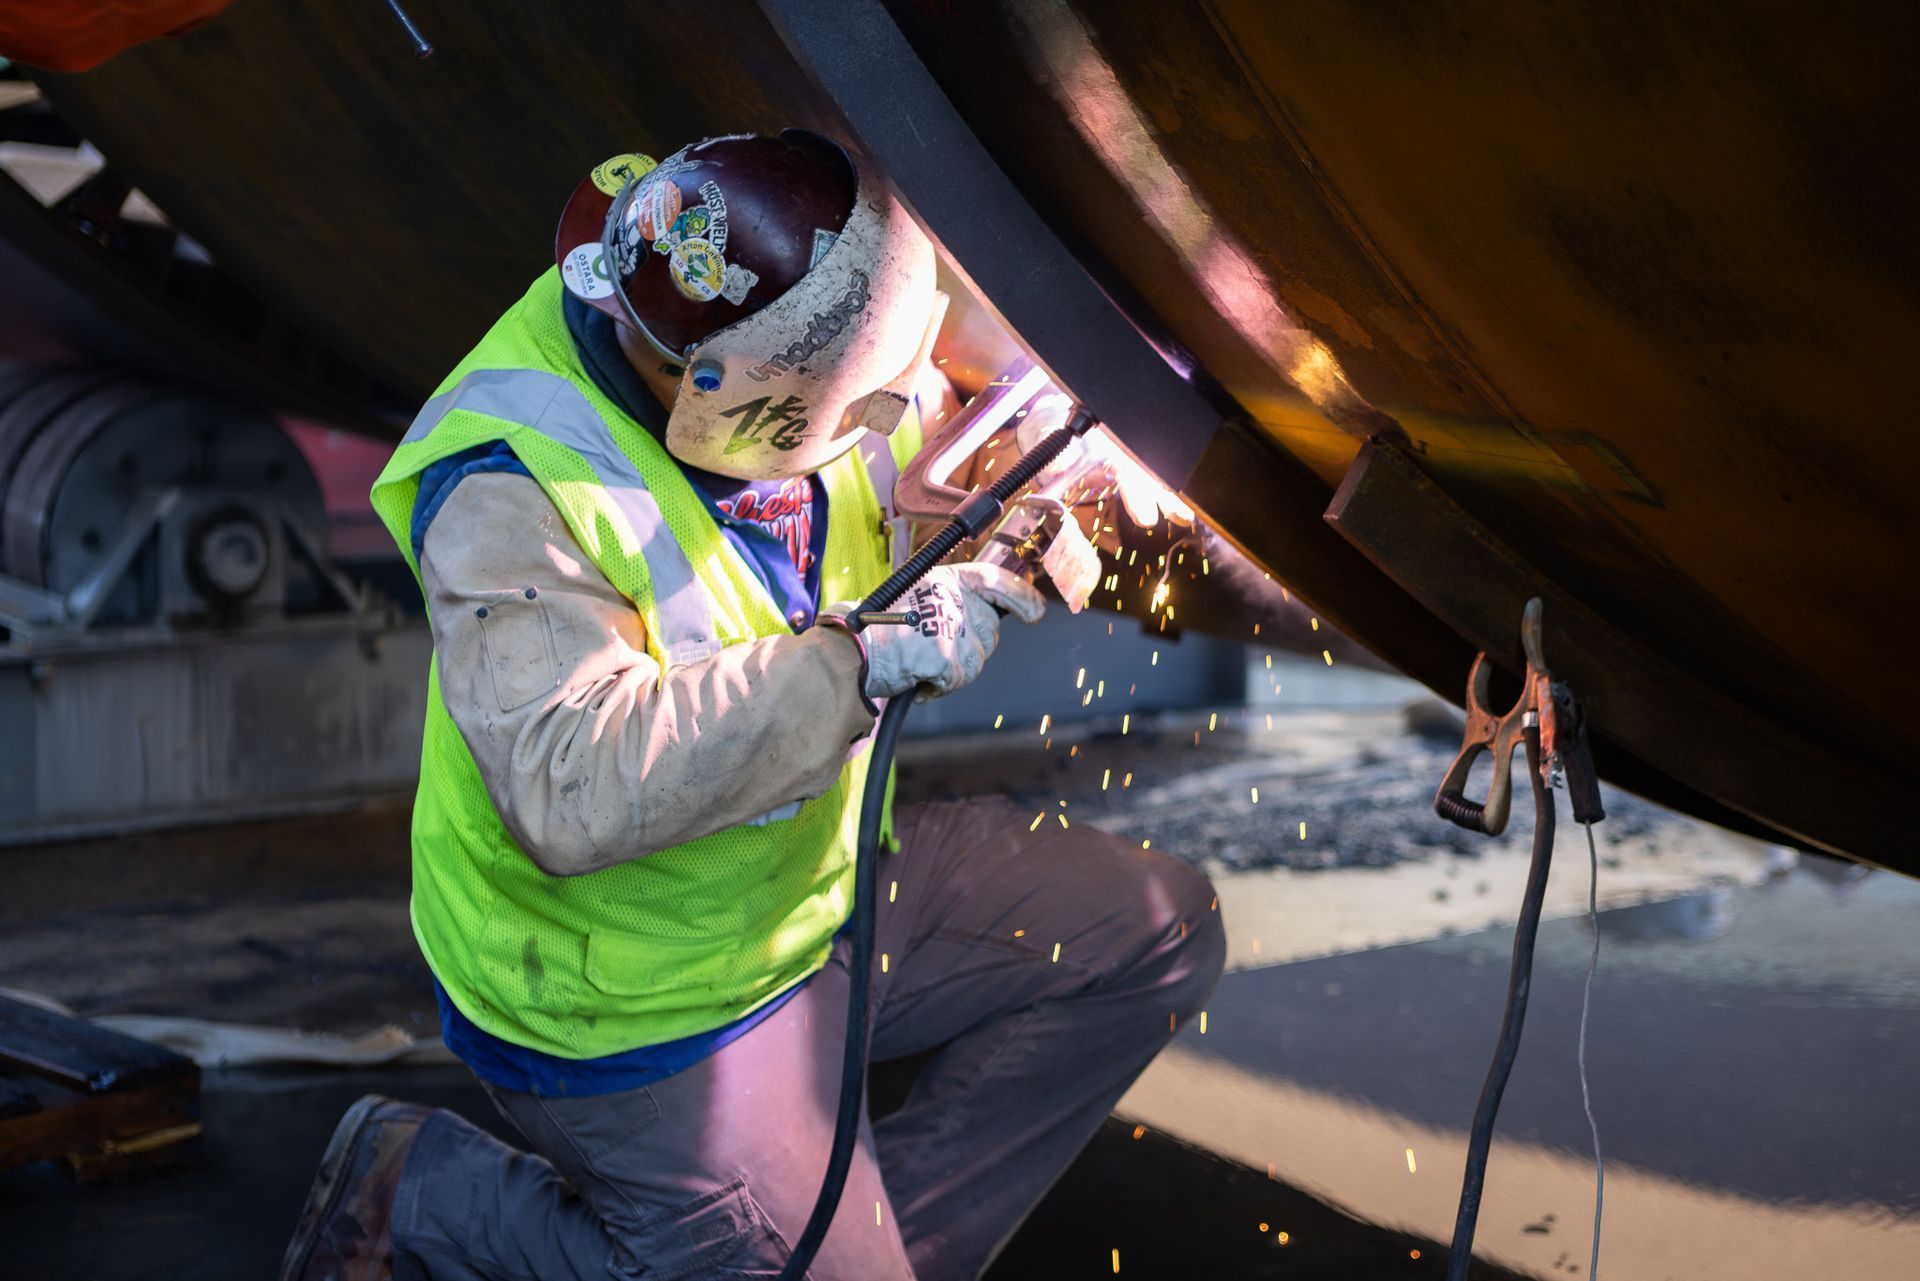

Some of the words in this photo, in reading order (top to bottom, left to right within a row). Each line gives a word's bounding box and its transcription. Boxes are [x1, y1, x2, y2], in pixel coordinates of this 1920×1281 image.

[700, 183, 725, 213] MUST
[578, 253, 595, 291] OSTARA
[914, 587, 939, 637] CUT
